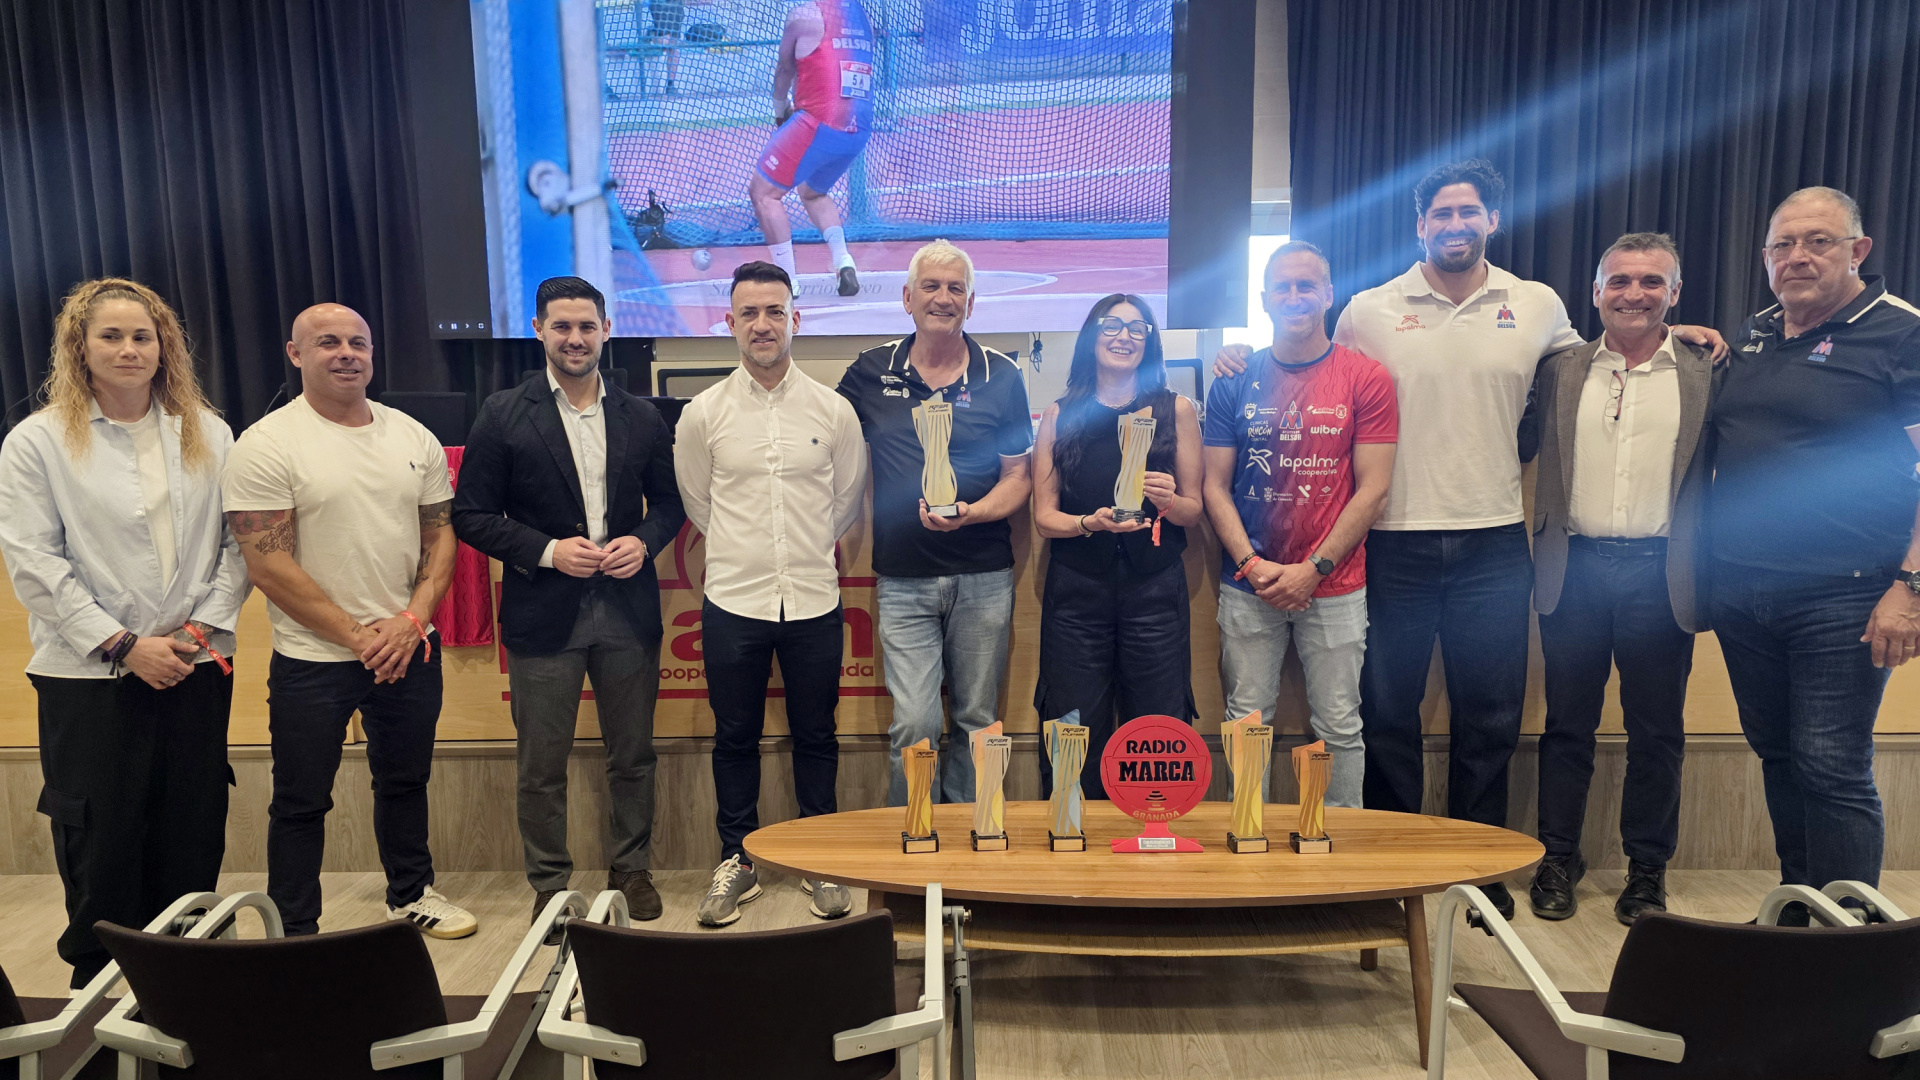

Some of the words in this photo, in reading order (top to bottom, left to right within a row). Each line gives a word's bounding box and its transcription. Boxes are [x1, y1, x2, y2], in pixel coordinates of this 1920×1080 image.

[1310, 424, 1344, 435] wiber
[1126, 740, 1187, 754] RADIO
[1118, 761, 1196, 782] MARCA
[1133, 810, 1180, 822] GRANADA
